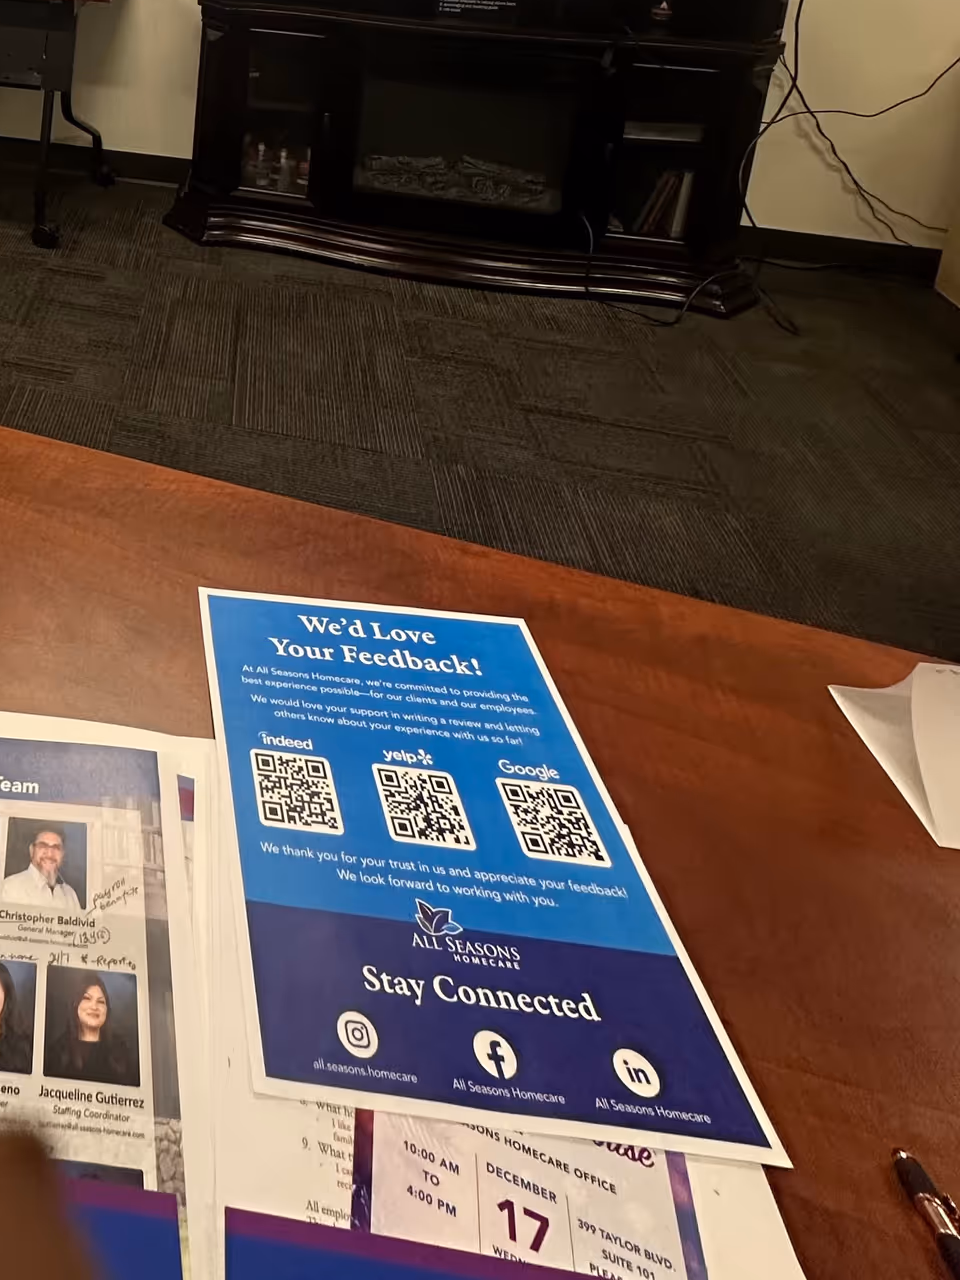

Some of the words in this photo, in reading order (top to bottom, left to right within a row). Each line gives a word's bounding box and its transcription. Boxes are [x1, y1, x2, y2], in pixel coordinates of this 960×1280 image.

[297, 615, 367, 638] We'd
[370, 622, 437, 645] Love
[268, 637, 334, 661] Your
[340, 644, 483, 676] Feedback!
[241, 676, 263, 685] best
[265, 679, 318, 692] experience
[406, 695, 437, 705] clients
[440, 698, 458, 707] and
[461, 701, 477, 709] our
[480, 703, 537, 715] employees.
[242, 664, 253, 673] At
[256, 666, 268, 674] All
[271, 668, 309, 679] Seasons
[312, 672, 364, 686] Homecare,
[366, 679, 392, 689] we're
[395, 682, 447, 694] committed
[463, 689, 510, 702] providing
[512, 693, 529, 702] the
[258, 731, 313, 750] indeed
[383, 749, 417, 765] yelp
[498, 759, 559, 781] Google
[260, 841, 280, 854] We
[282, 846, 314, 859] thank
[317, 851, 338, 863] you
[341, 851, 357, 864] for
[360, 857, 385, 868] your
[389, 859, 416, 871] trust
[418, 861, 429, 873] in
[432, 865, 446, 875] us
[449, 867, 471, 878] and
[474, 870, 536, 886] appreciate
[540, 878, 565, 890] your
[568, 879, 628, 898] feedback!
[337, 868, 357, 882] We
[360, 872, 385, 885] look
[389, 875, 434, 891] forward
[437, 882, 449, 893] to
[452, 885, 501, 902] working
[504, 891, 530, 904] with
[532, 896, 559, 907] you.
[0, 910, 55, 924] Christopher
[57, 916, 95, 928] Baldivid
[18, 924, 44, 933] General
[45, 928, 74, 937] Manager
[412, 932, 443, 950] ALL
[445, 936, 521, 960] SEASONS
[453, 953, 521, 970] HOMECARE
[362, 965, 425, 1006] Stay
[433, 975, 601, 1021] Connected
[313, 1058, 418, 1084] all.seasons.homecare
[39, 1085, 93, 1103] Jacqueline
[95, 1091, 144, 1109] Gutierrez
[453, 1078, 466, 1091] All
[468, 1081, 510, 1098] Seasons
[511, 1087, 566, 1105] Homecare
[53, 1105, 82, 1119] Staffing
[84, 1108, 130, 1123] Coordinator
[595, 1097, 609, 1110] All
[611, 1100, 655, 1116] Seasons
[655, 1106, 711, 1124] Homecare
[404, 1139, 435, 1164] 10:00
[440, 1158, 461, 1176] AM
[504, 1136, 570, 1174] HOMECARE
[574, 1168, 618, 1195] OFFICE
[422, 1169, 440, 1186] TO
[486, 1162, 558, 1204] DECEMBER
[406, 1187, 433, 1205] 4:00
[437, 1199, 457, 1218] PM
[496, 1198, 550, 1253] 17
[577, 1219, 597, 1235] 399
[598, 1228, 641, 1255] TAYLOR
[644, 1245, 676, 1272] BLVD.
[601, 1248, 633, 1272] SUITE
[637, 1265, 655, 1280] 101
